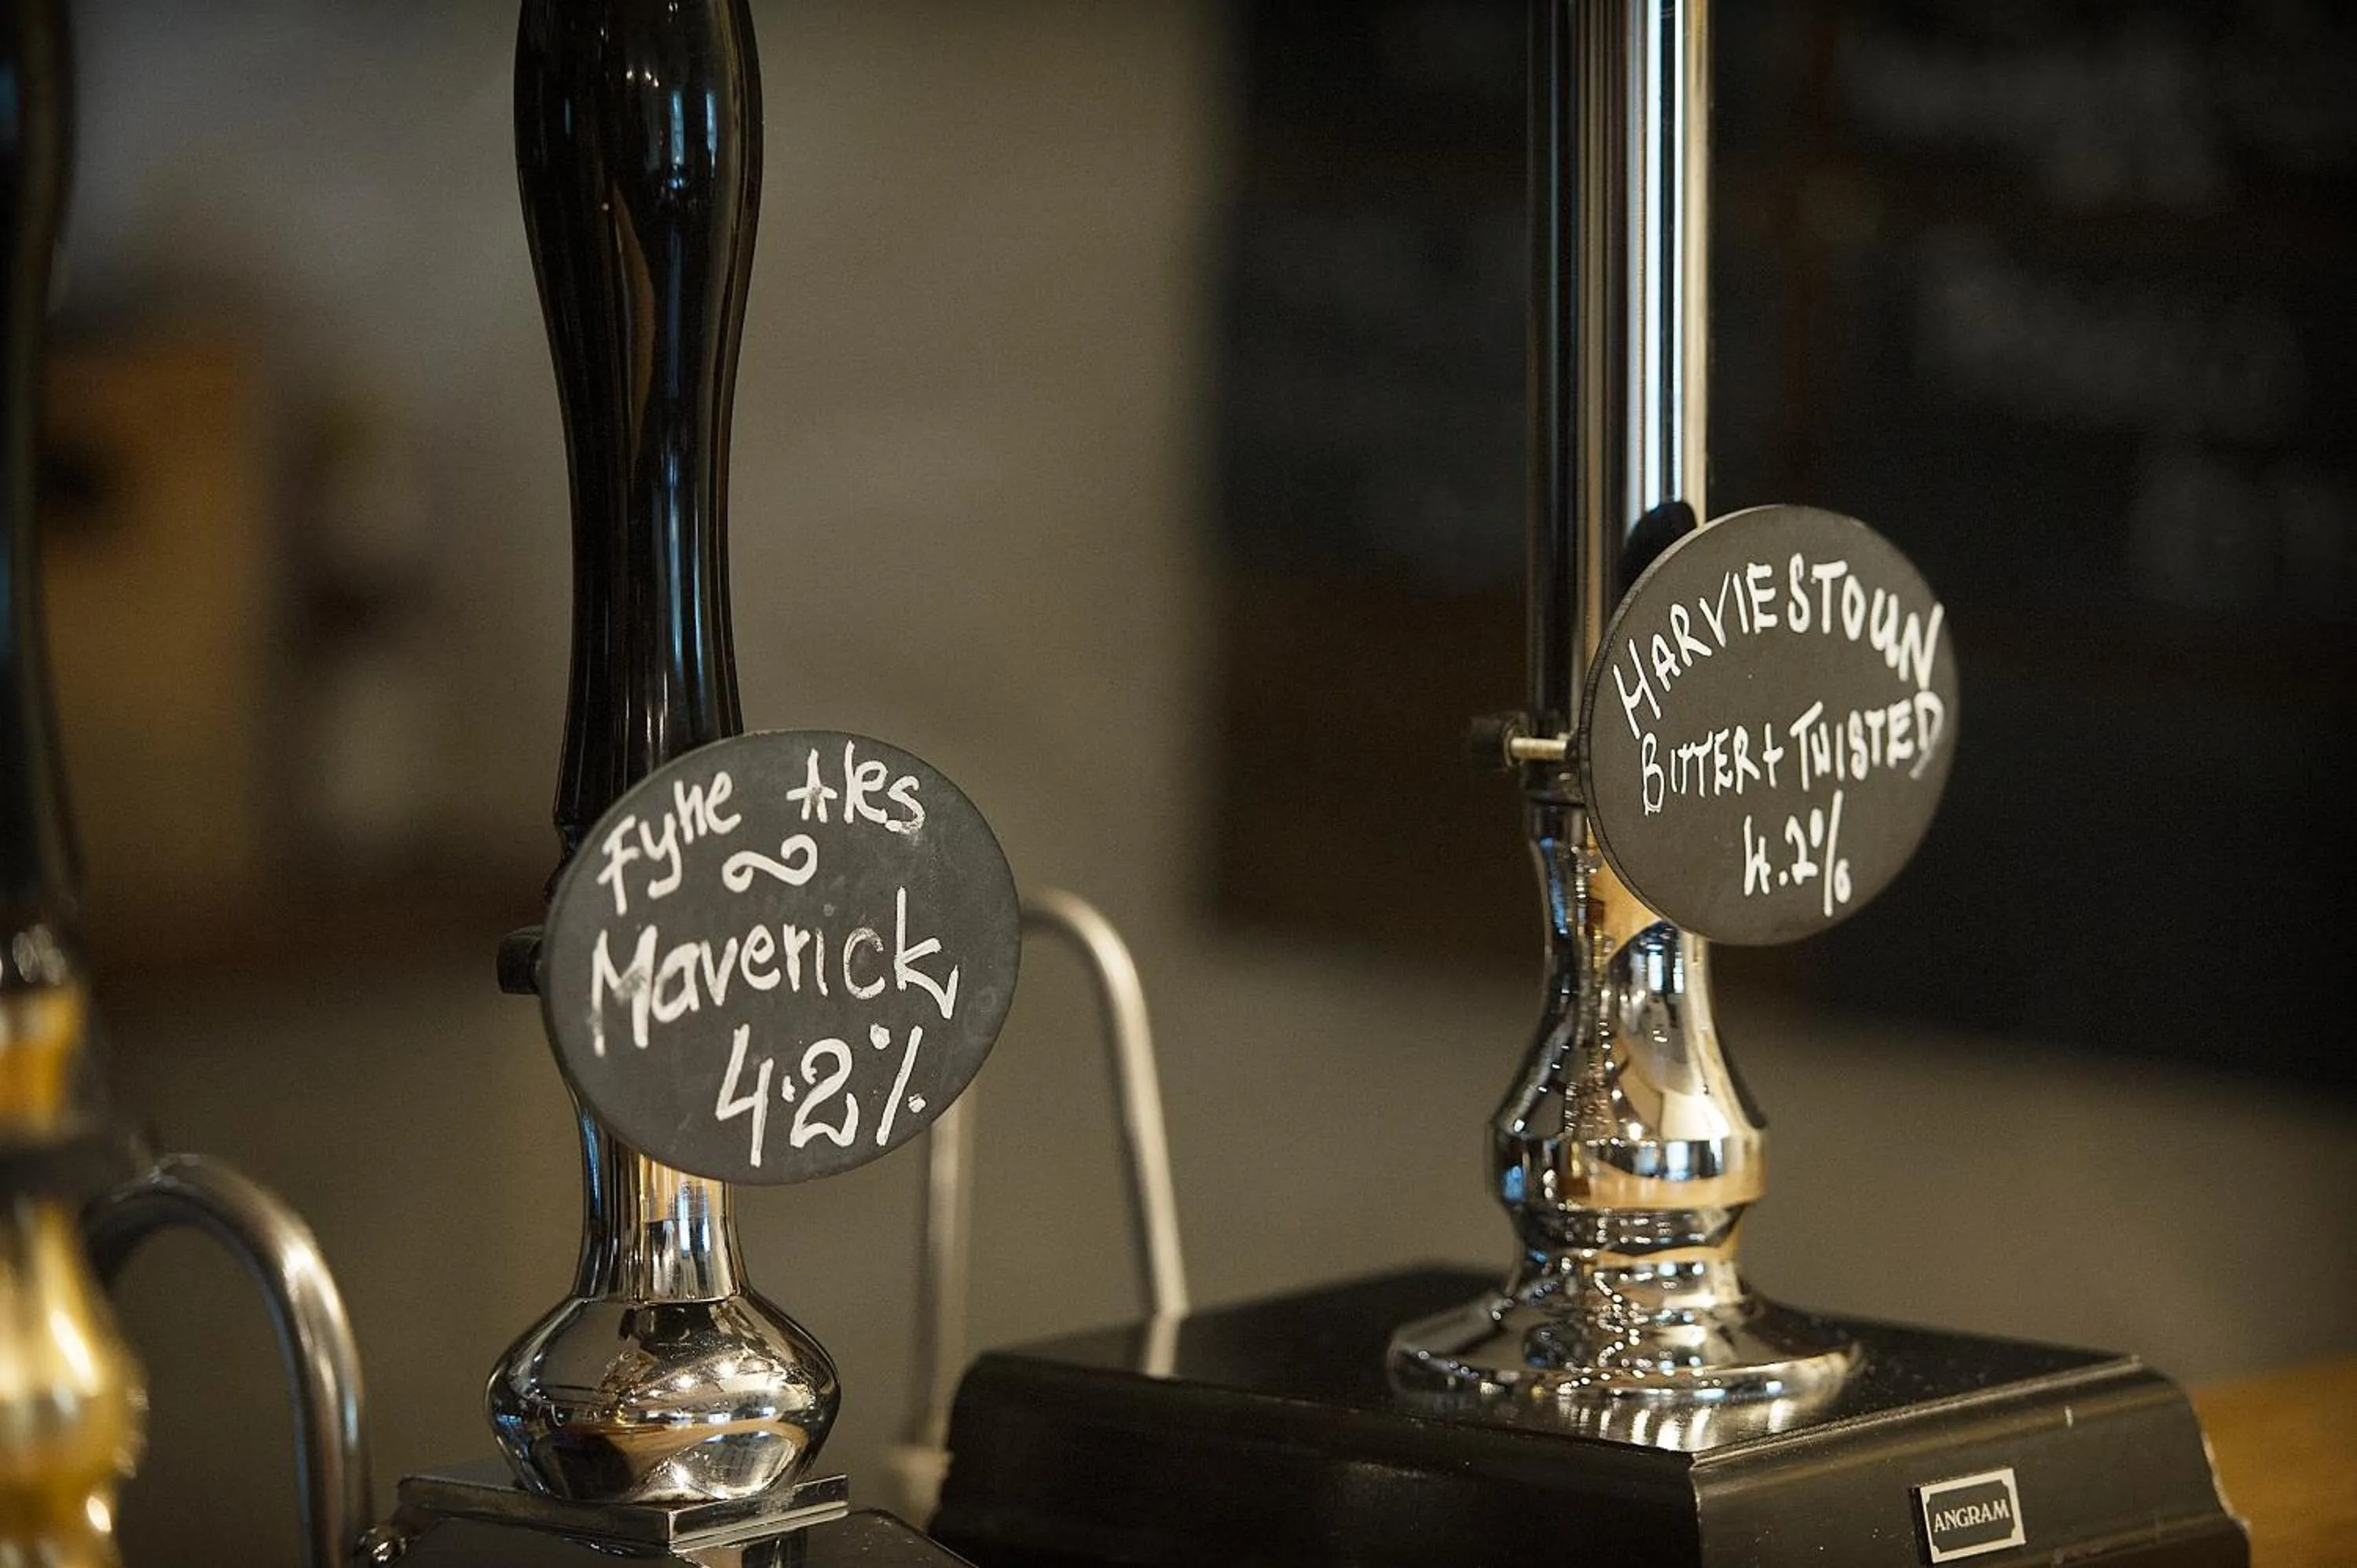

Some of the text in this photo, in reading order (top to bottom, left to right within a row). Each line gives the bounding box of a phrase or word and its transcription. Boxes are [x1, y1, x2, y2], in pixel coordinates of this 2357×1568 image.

[1743, 789, 1853, 918] 4.2%
[591, 885, 959, 1057] Maverick
[1934, 1498, 2011, 1533] ANGRAM
